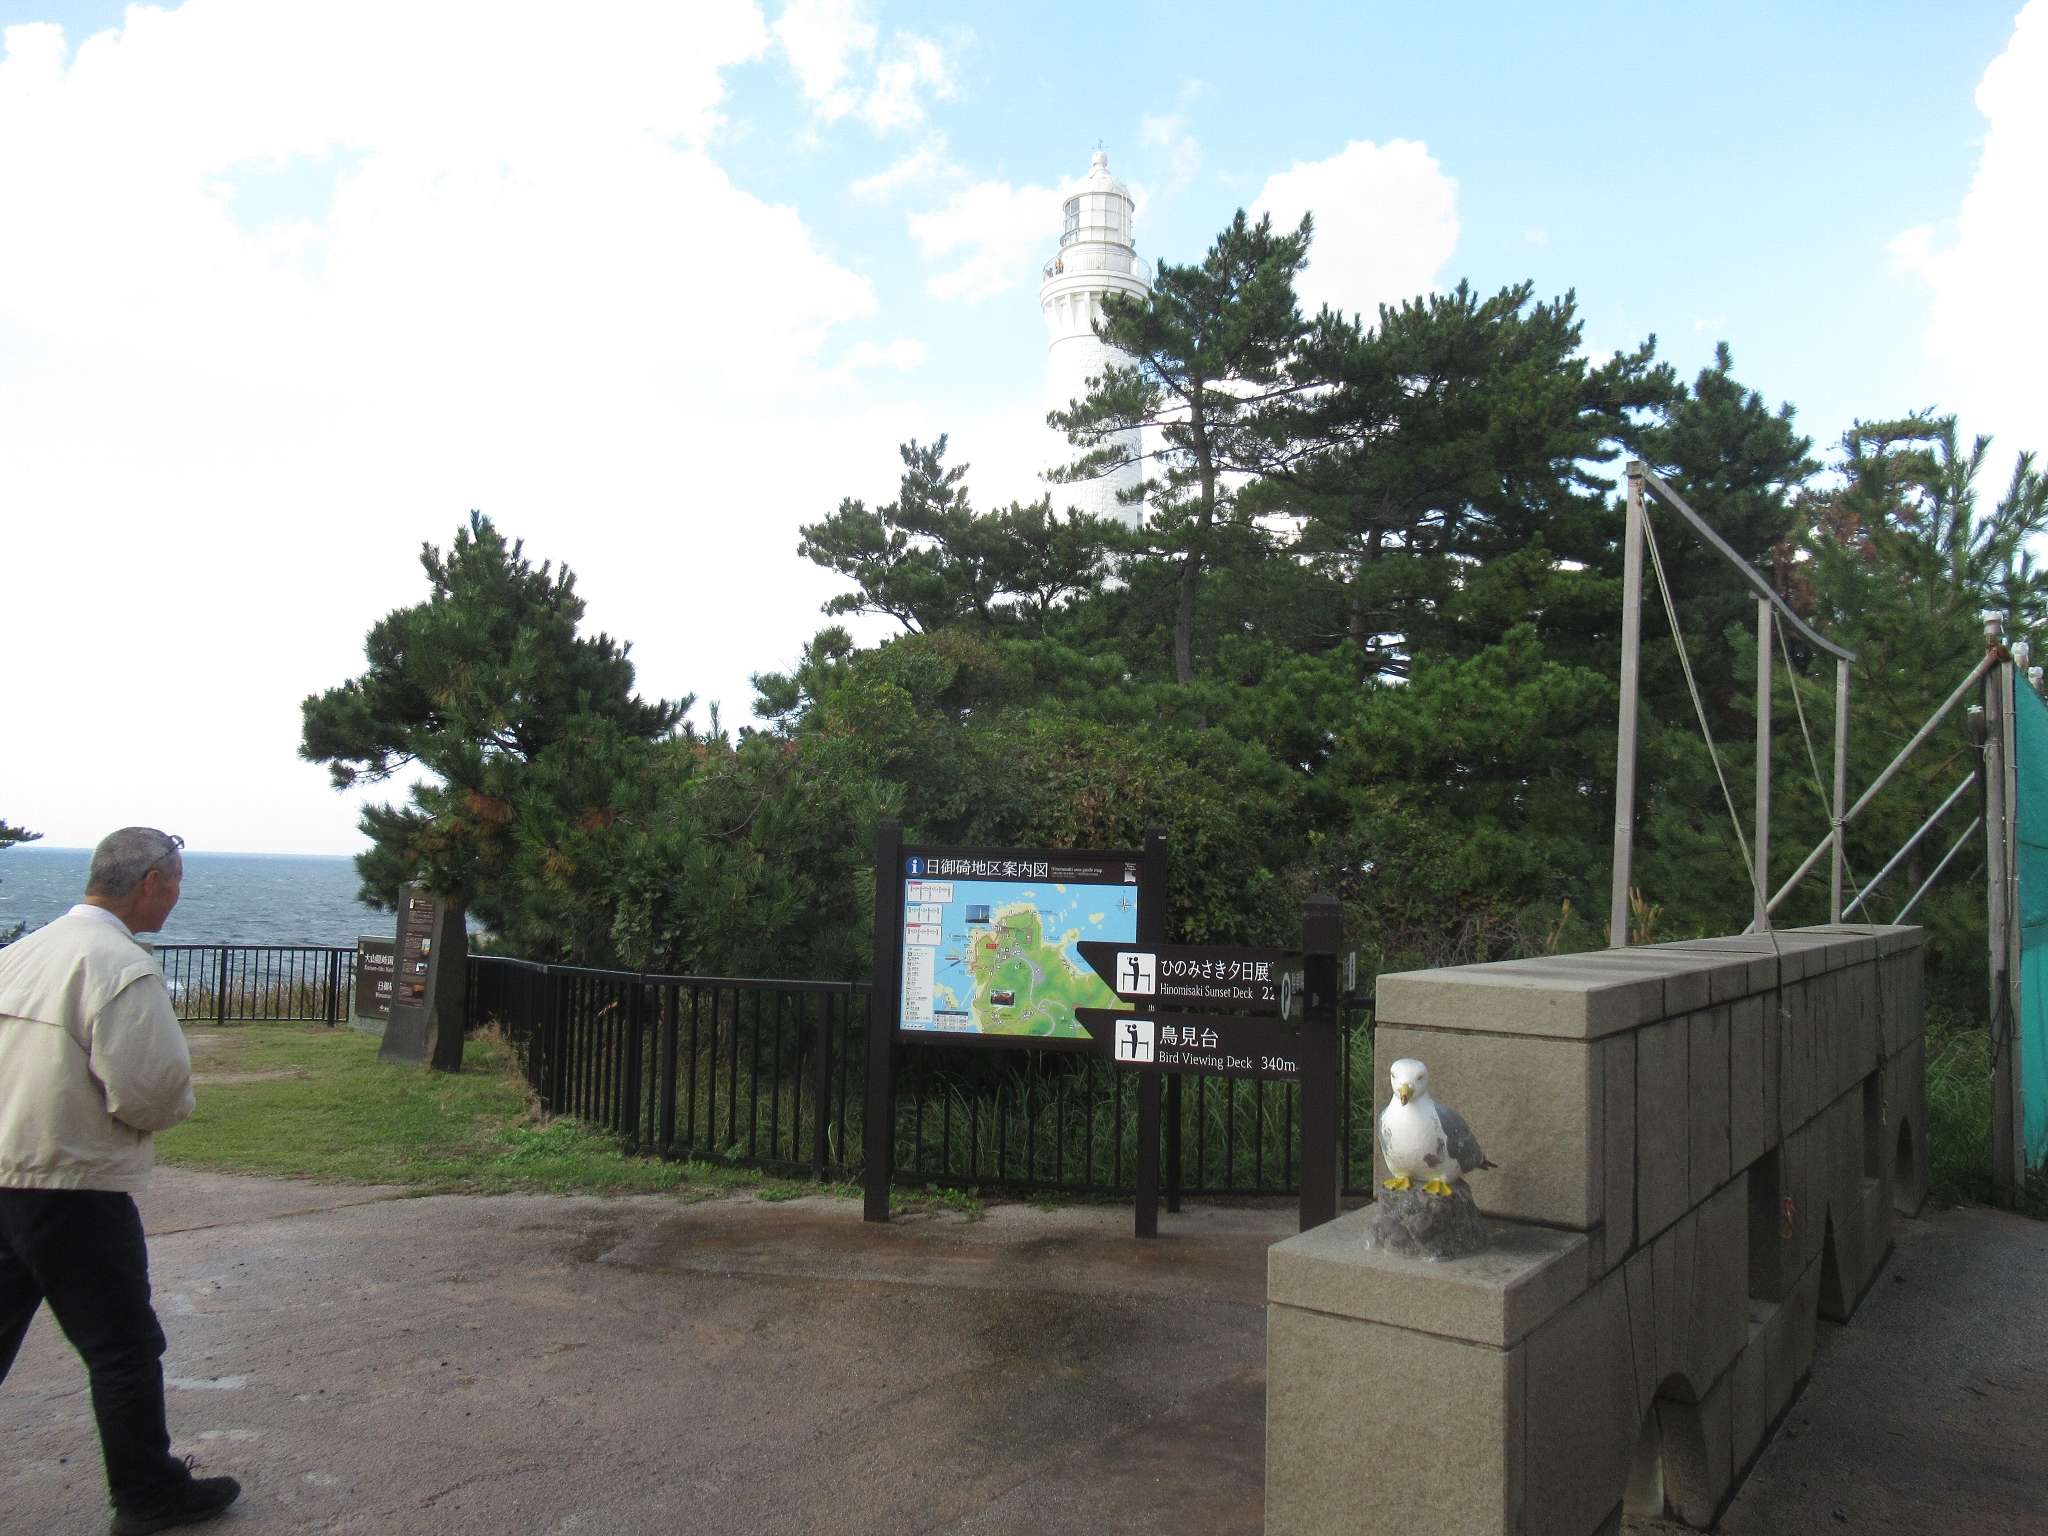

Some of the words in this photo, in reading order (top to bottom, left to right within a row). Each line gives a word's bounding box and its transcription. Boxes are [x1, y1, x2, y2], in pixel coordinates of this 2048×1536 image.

[926, 859, 1049, 878] 日御碕地区案内図
[1160, 960, 1274, 982] ひのみさき夕日展
[1160, 983, 1203, 998] Hinomisaki
[1204, 985, 1231, 998] Sunset
[1233, 986, 1253, 1000] Deck
[1159, 1025, 1219, 1049] 鳥見台
[1159, 1051, 1179, 1064] Bird
[1182, 1053, 1224, 1070] Viewing
[1227, 1056, 1253, 1070] Deck
[1261, 1056, 1297, 1072] 340m
